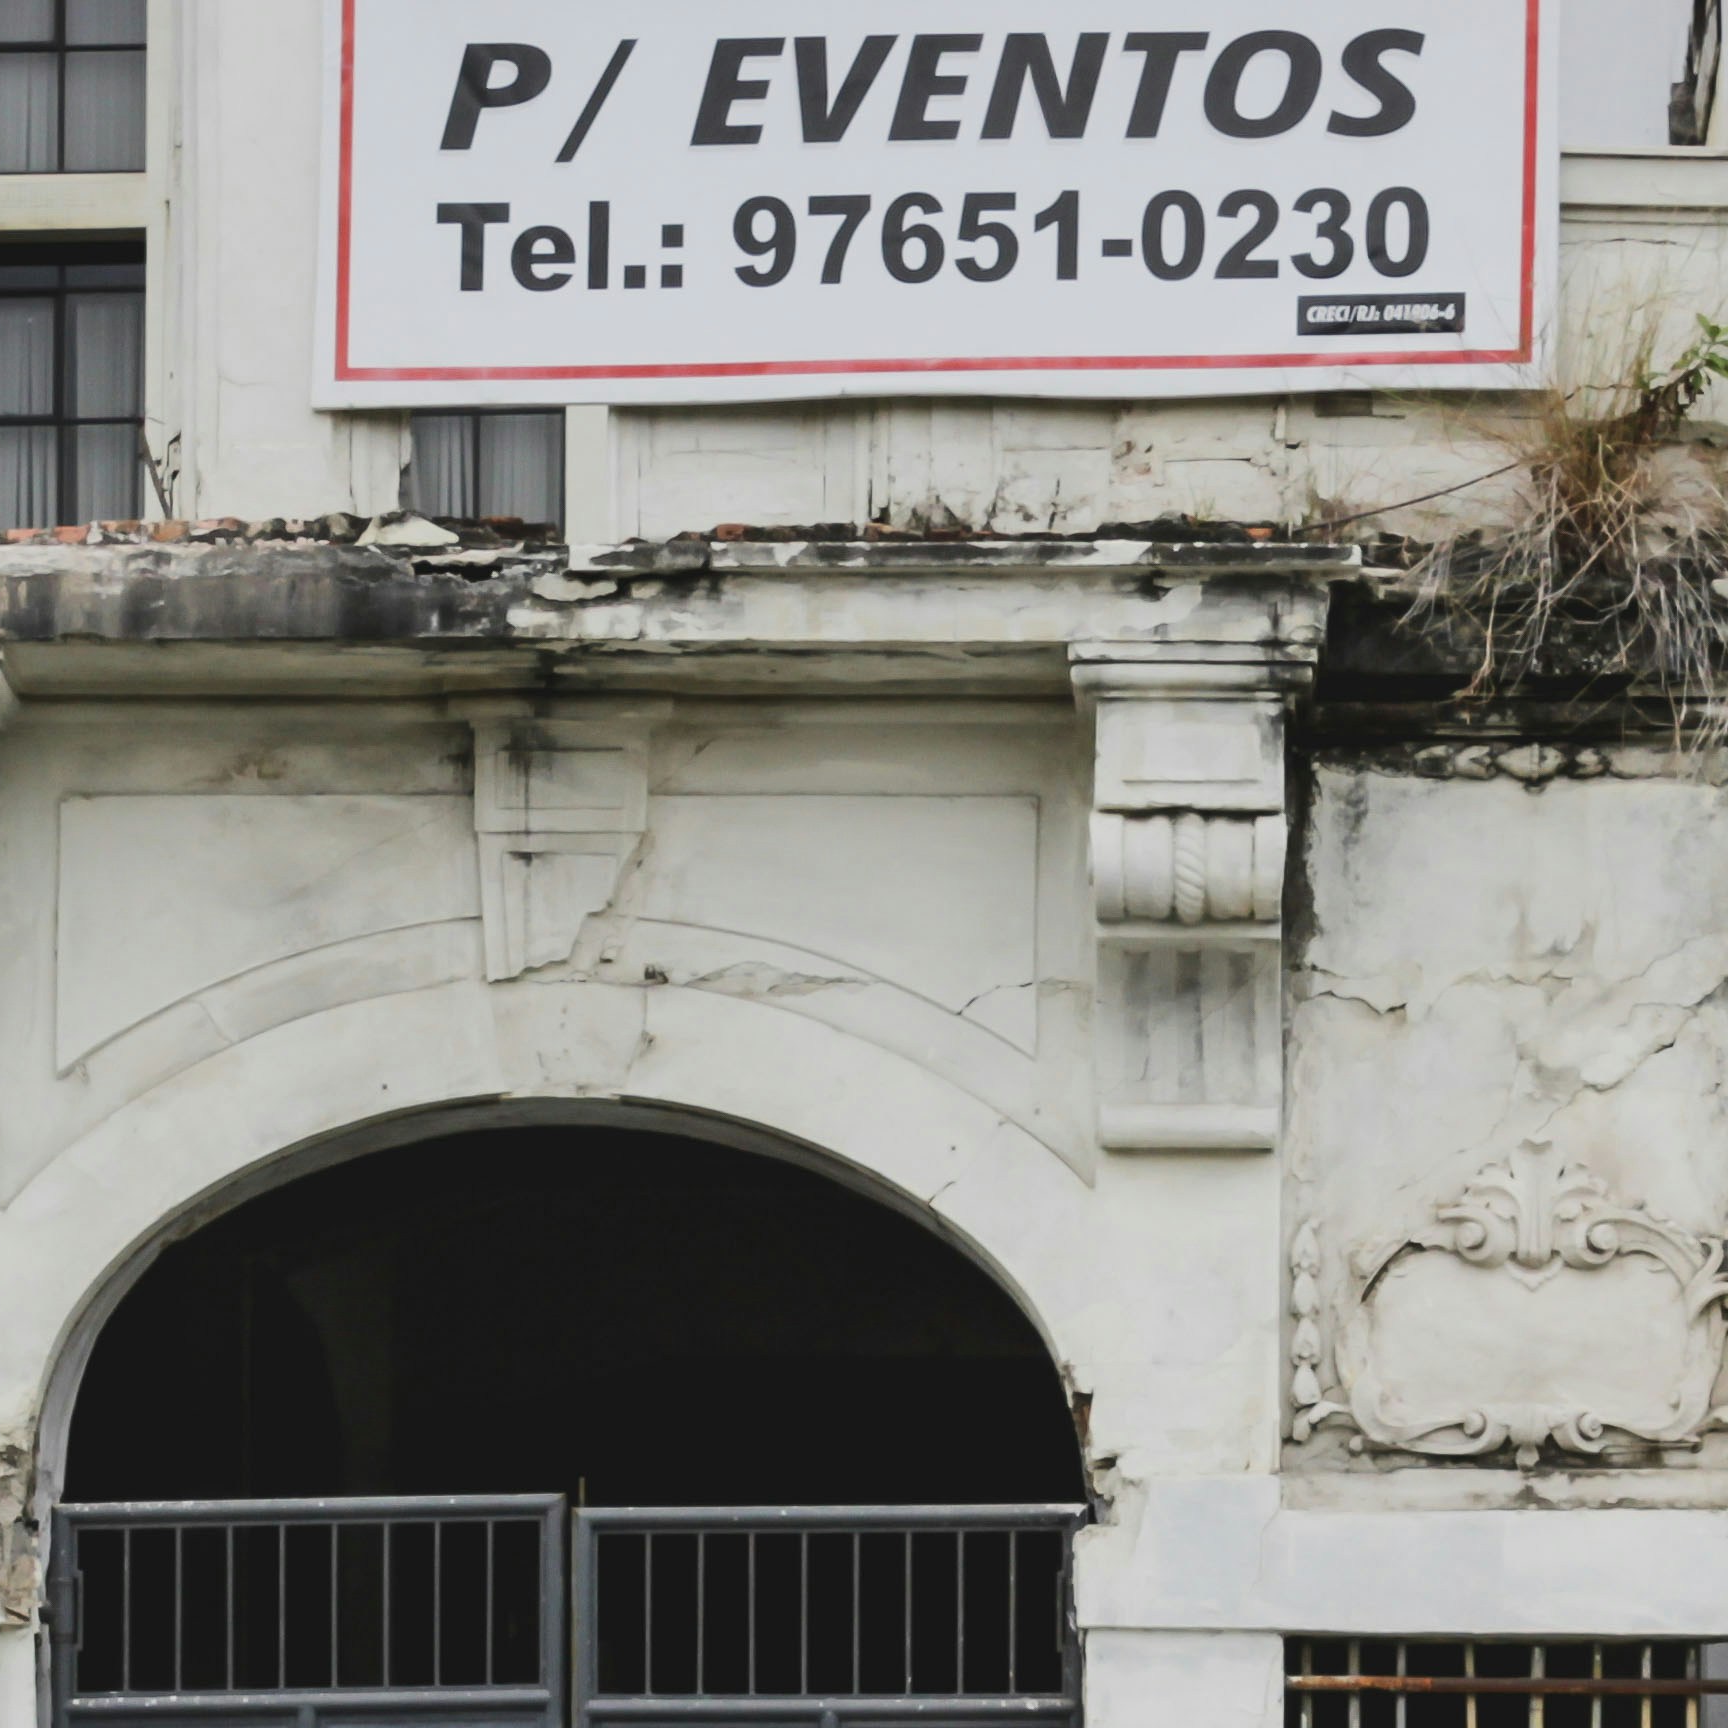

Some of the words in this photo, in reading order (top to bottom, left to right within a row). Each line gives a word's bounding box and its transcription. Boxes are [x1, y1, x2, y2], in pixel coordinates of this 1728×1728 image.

[439, 38, 638, 164] P/
[690, 28, 1426, 147] EVENTOS
[437, 201, 685, 292] Tel.:
[733, 187, 1430, 287] 97651-0230
